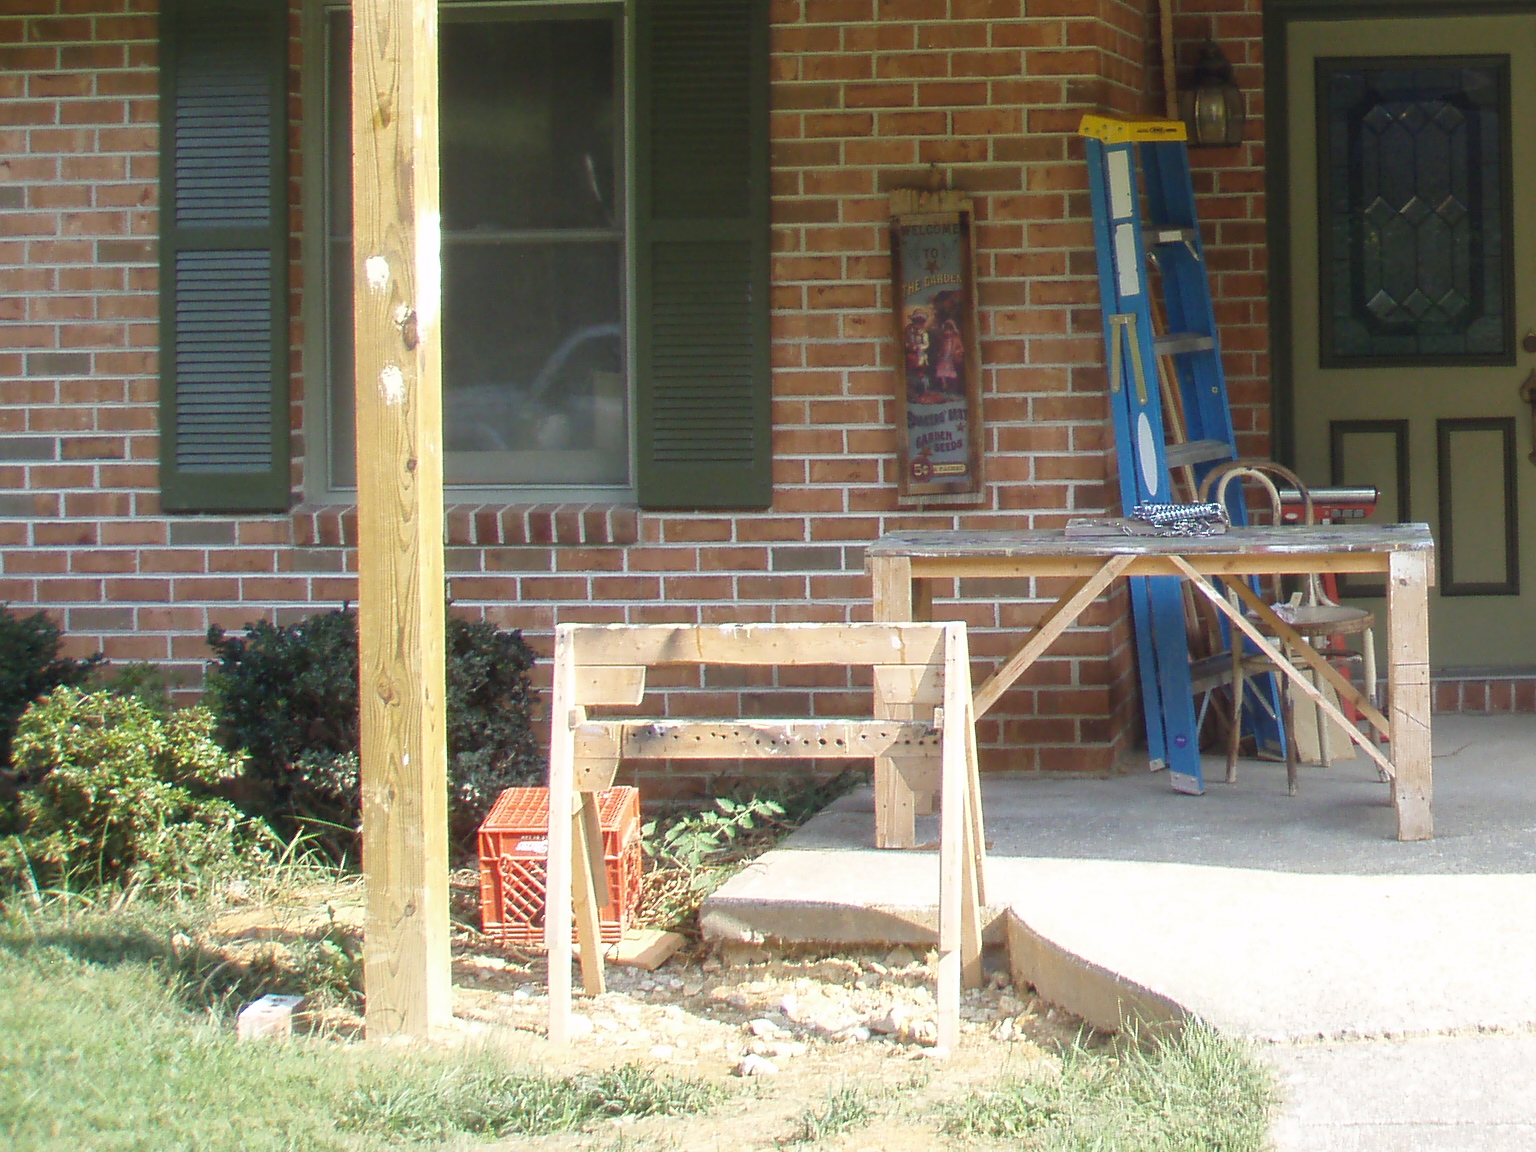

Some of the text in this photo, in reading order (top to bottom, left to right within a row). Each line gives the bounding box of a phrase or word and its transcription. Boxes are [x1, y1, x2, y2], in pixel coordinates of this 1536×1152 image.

[900, 224, 960, 236] WELCOME
[923, 247, 939, 259] TO
[902, 273, 962, 299] THE GARDEN
[915, 431, 953, 449] GARDEN
[934, 439, 963, 452] SEEDS
